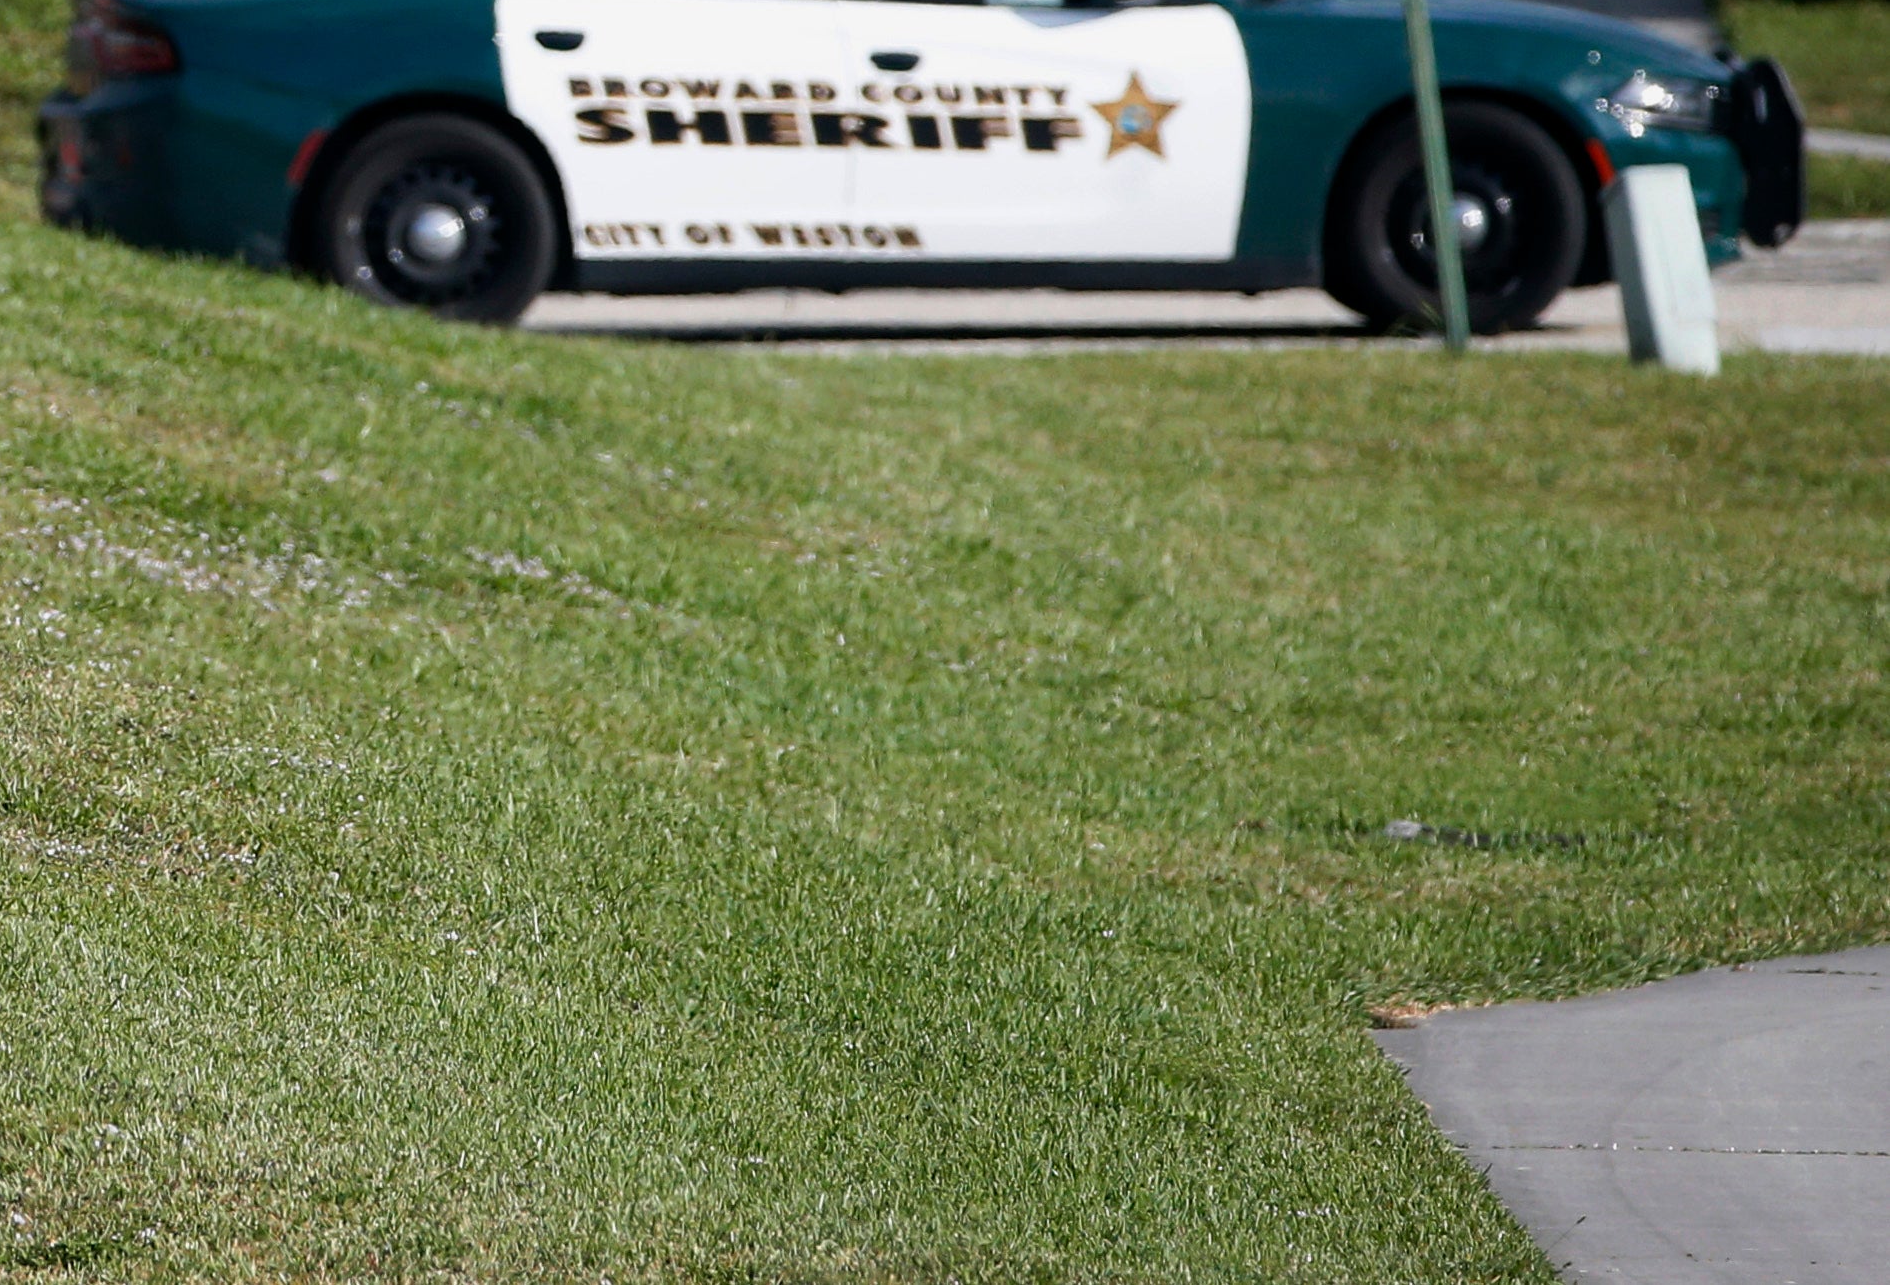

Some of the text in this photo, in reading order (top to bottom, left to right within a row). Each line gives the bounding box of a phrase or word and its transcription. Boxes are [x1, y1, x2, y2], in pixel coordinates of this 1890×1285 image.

[567, 76, 1070, 107] BROWARD COUNTY
[574, 107, 1085, 153] SHERIFF
[584, 223, 666, 247] CITY
